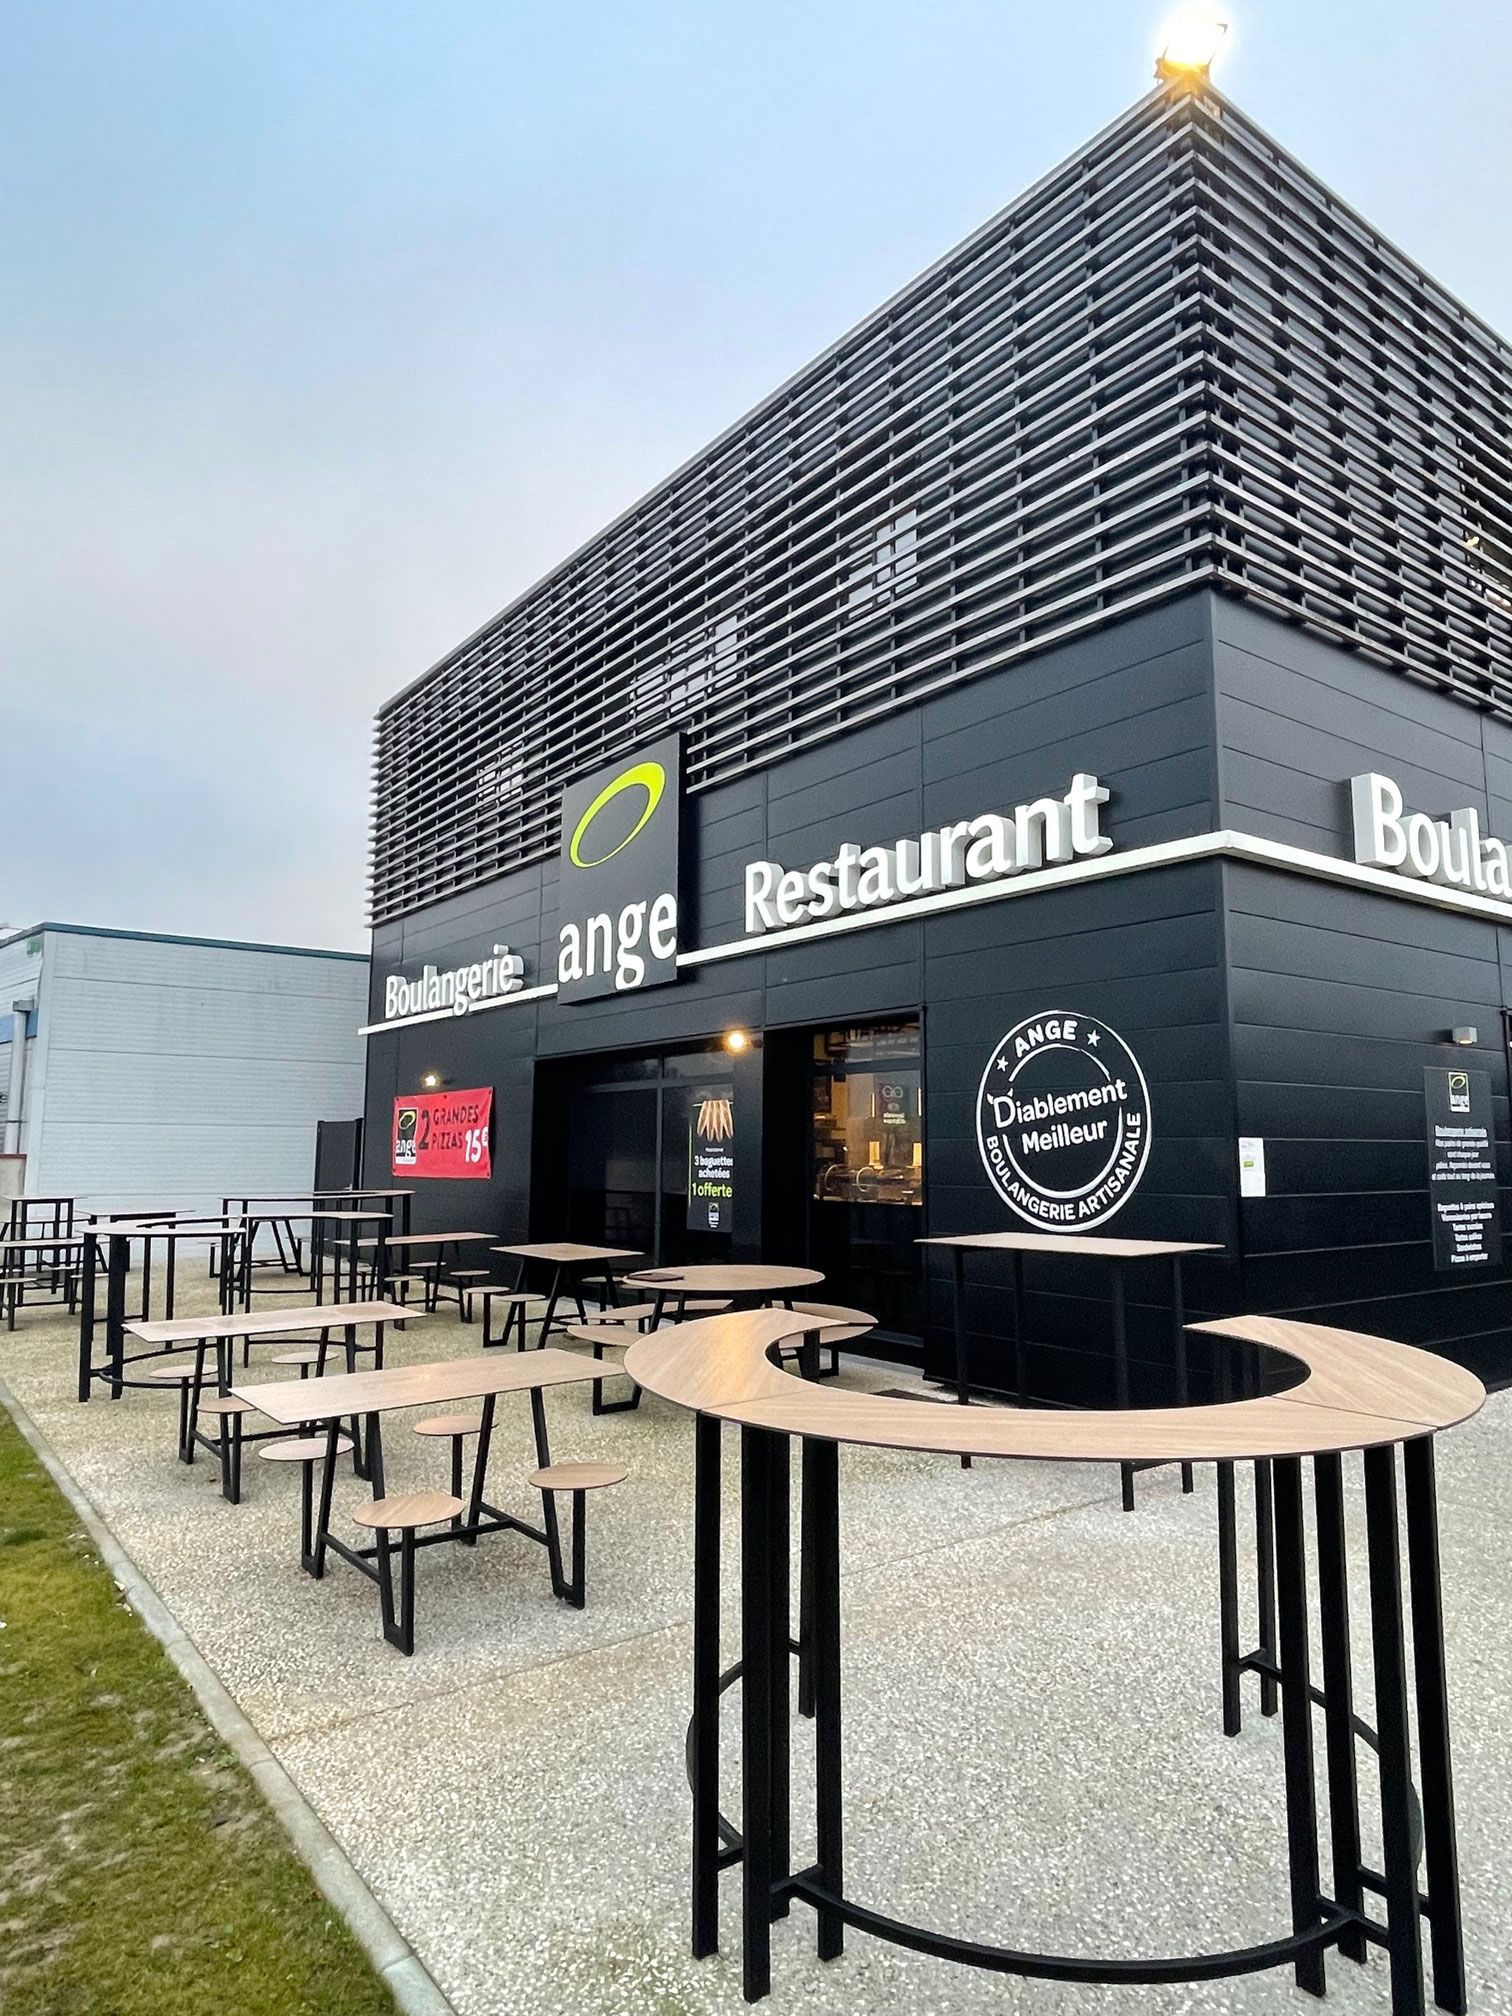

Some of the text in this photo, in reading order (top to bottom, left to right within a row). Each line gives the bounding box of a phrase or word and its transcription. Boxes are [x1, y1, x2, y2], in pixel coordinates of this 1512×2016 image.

[745, 773, 1113, 933] Restaurant
[1351, 772, 1512, 898] Boula
[558, 892, 677, 990] ange
[385, 944, 525, 1018] Boulangerie
[1013, 1020, 1078, 1058] ANGE
[432, 1104, 479, 1126] GRANDES
[990, 1078, 1128, 1129] Diablement
[418, 1110, 430, 1150] 2
[431, 1131, 463, 1151] PIZZAS
[1021, 1119, 1108, 1154] Meilleur
[694, 1155, 699, 1166] 3
[986, 1112, 1141, 1221] BOULANGERIE ARTISANALE
[698, 1182, 733, 1197] offerte
